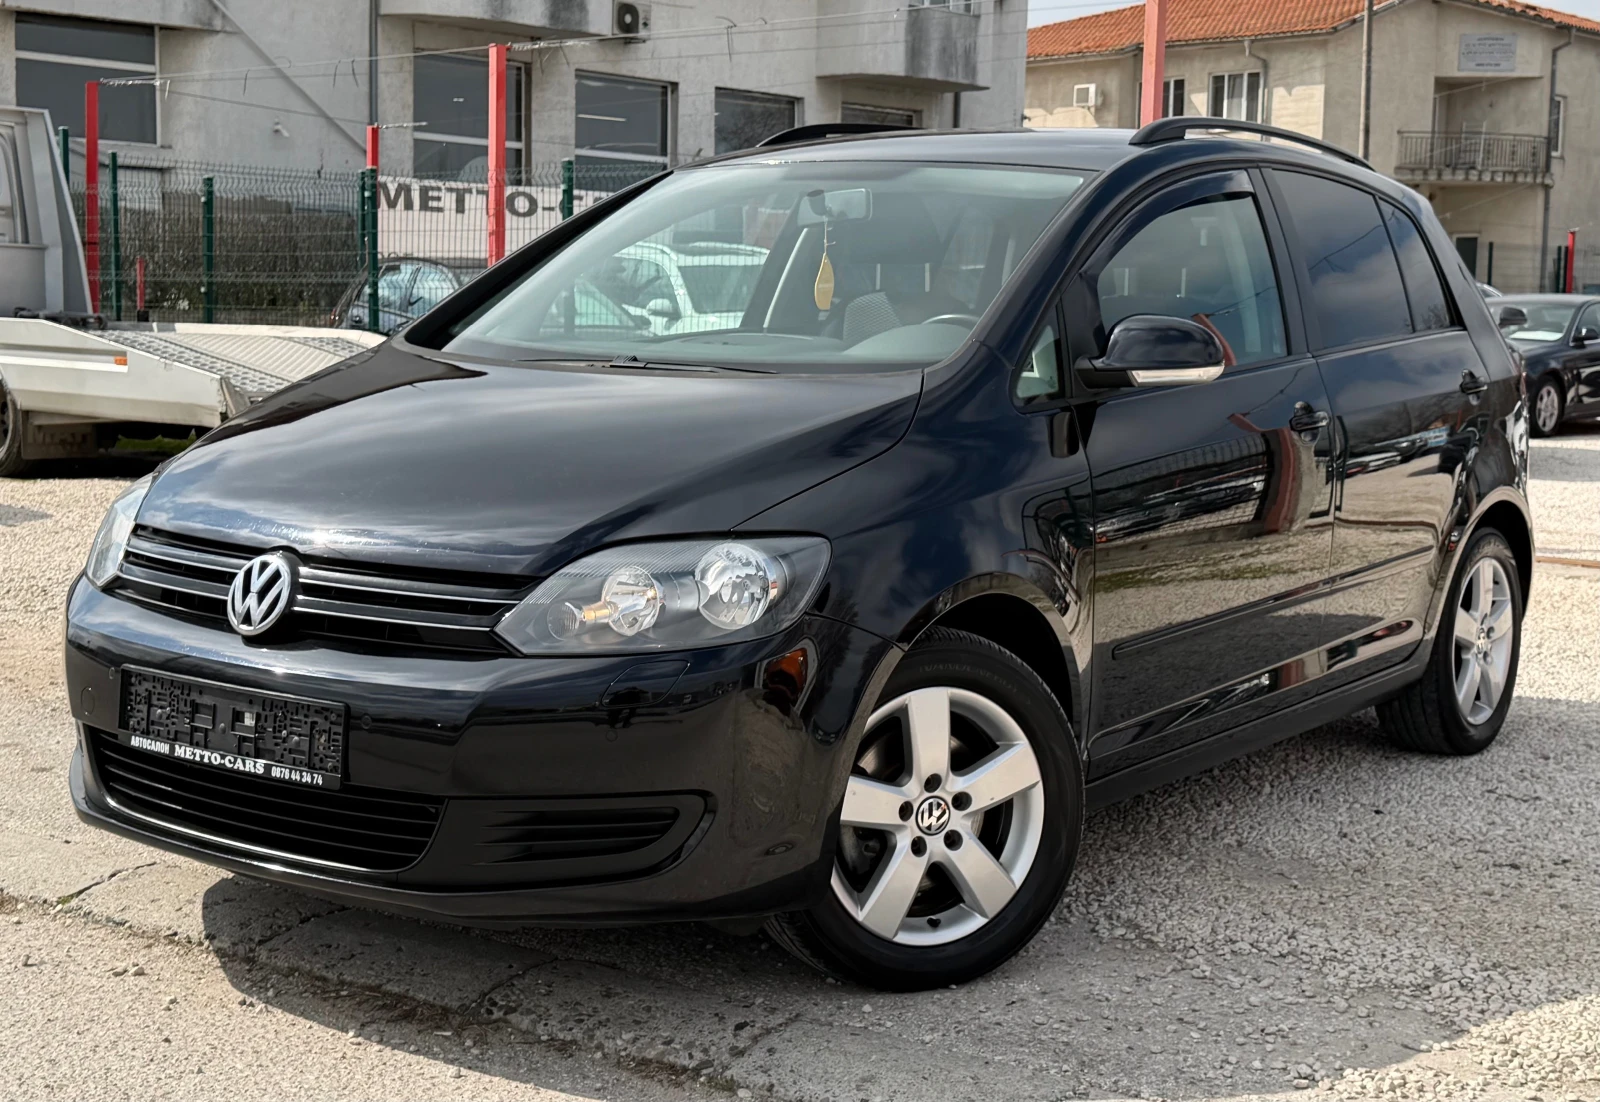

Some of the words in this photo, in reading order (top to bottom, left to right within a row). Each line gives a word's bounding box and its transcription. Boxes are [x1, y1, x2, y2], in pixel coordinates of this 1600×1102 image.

[379, 182, 605, 217] METO-
[130, 735, 170, 755] АВТОСАЛОН
[174, 744, 265, 774] METTO-CARS
[271, 765, 290, 780] 0876
[290, 769, 301, 782] 44
[301, 771, 312, 784] 34
[312, 773, 323, 786] 74
